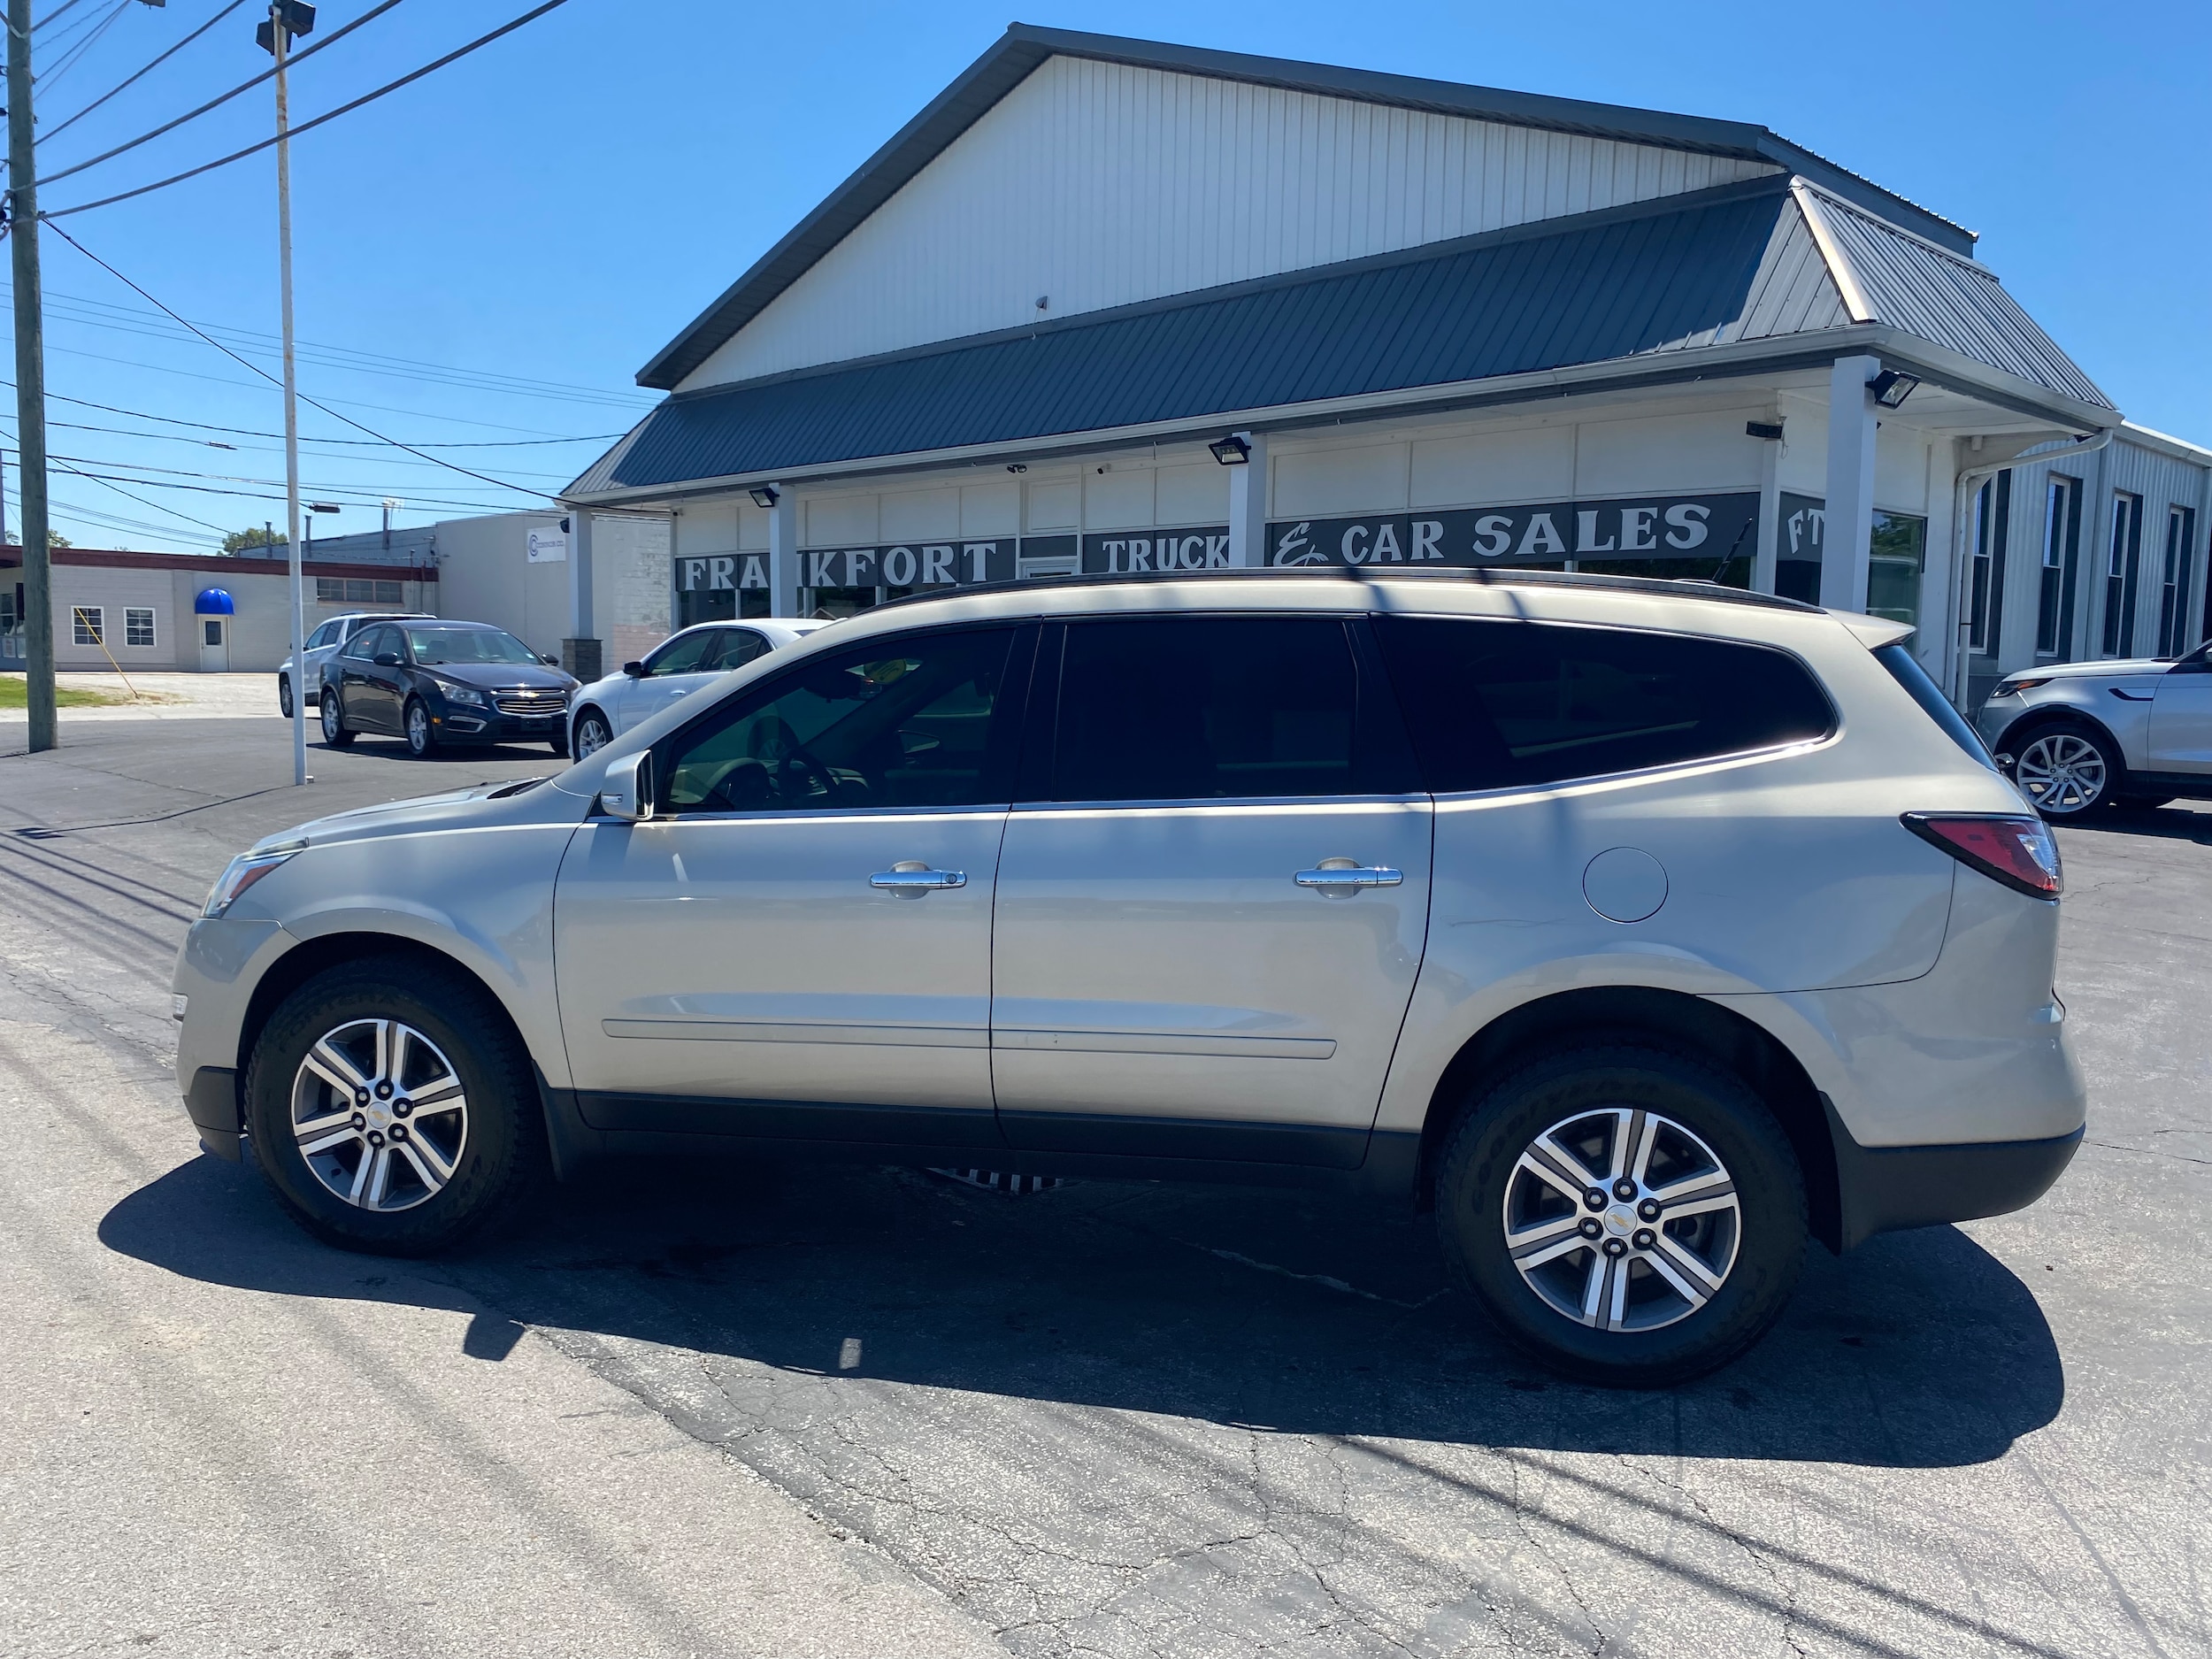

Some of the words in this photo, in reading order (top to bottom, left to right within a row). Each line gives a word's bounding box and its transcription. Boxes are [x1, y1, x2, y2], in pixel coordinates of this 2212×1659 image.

[684, 542, 997, 591] FRAKFORT
[1340, 520, 1445, 565] CAR
[1472, 503, 1711, 557] SALES
